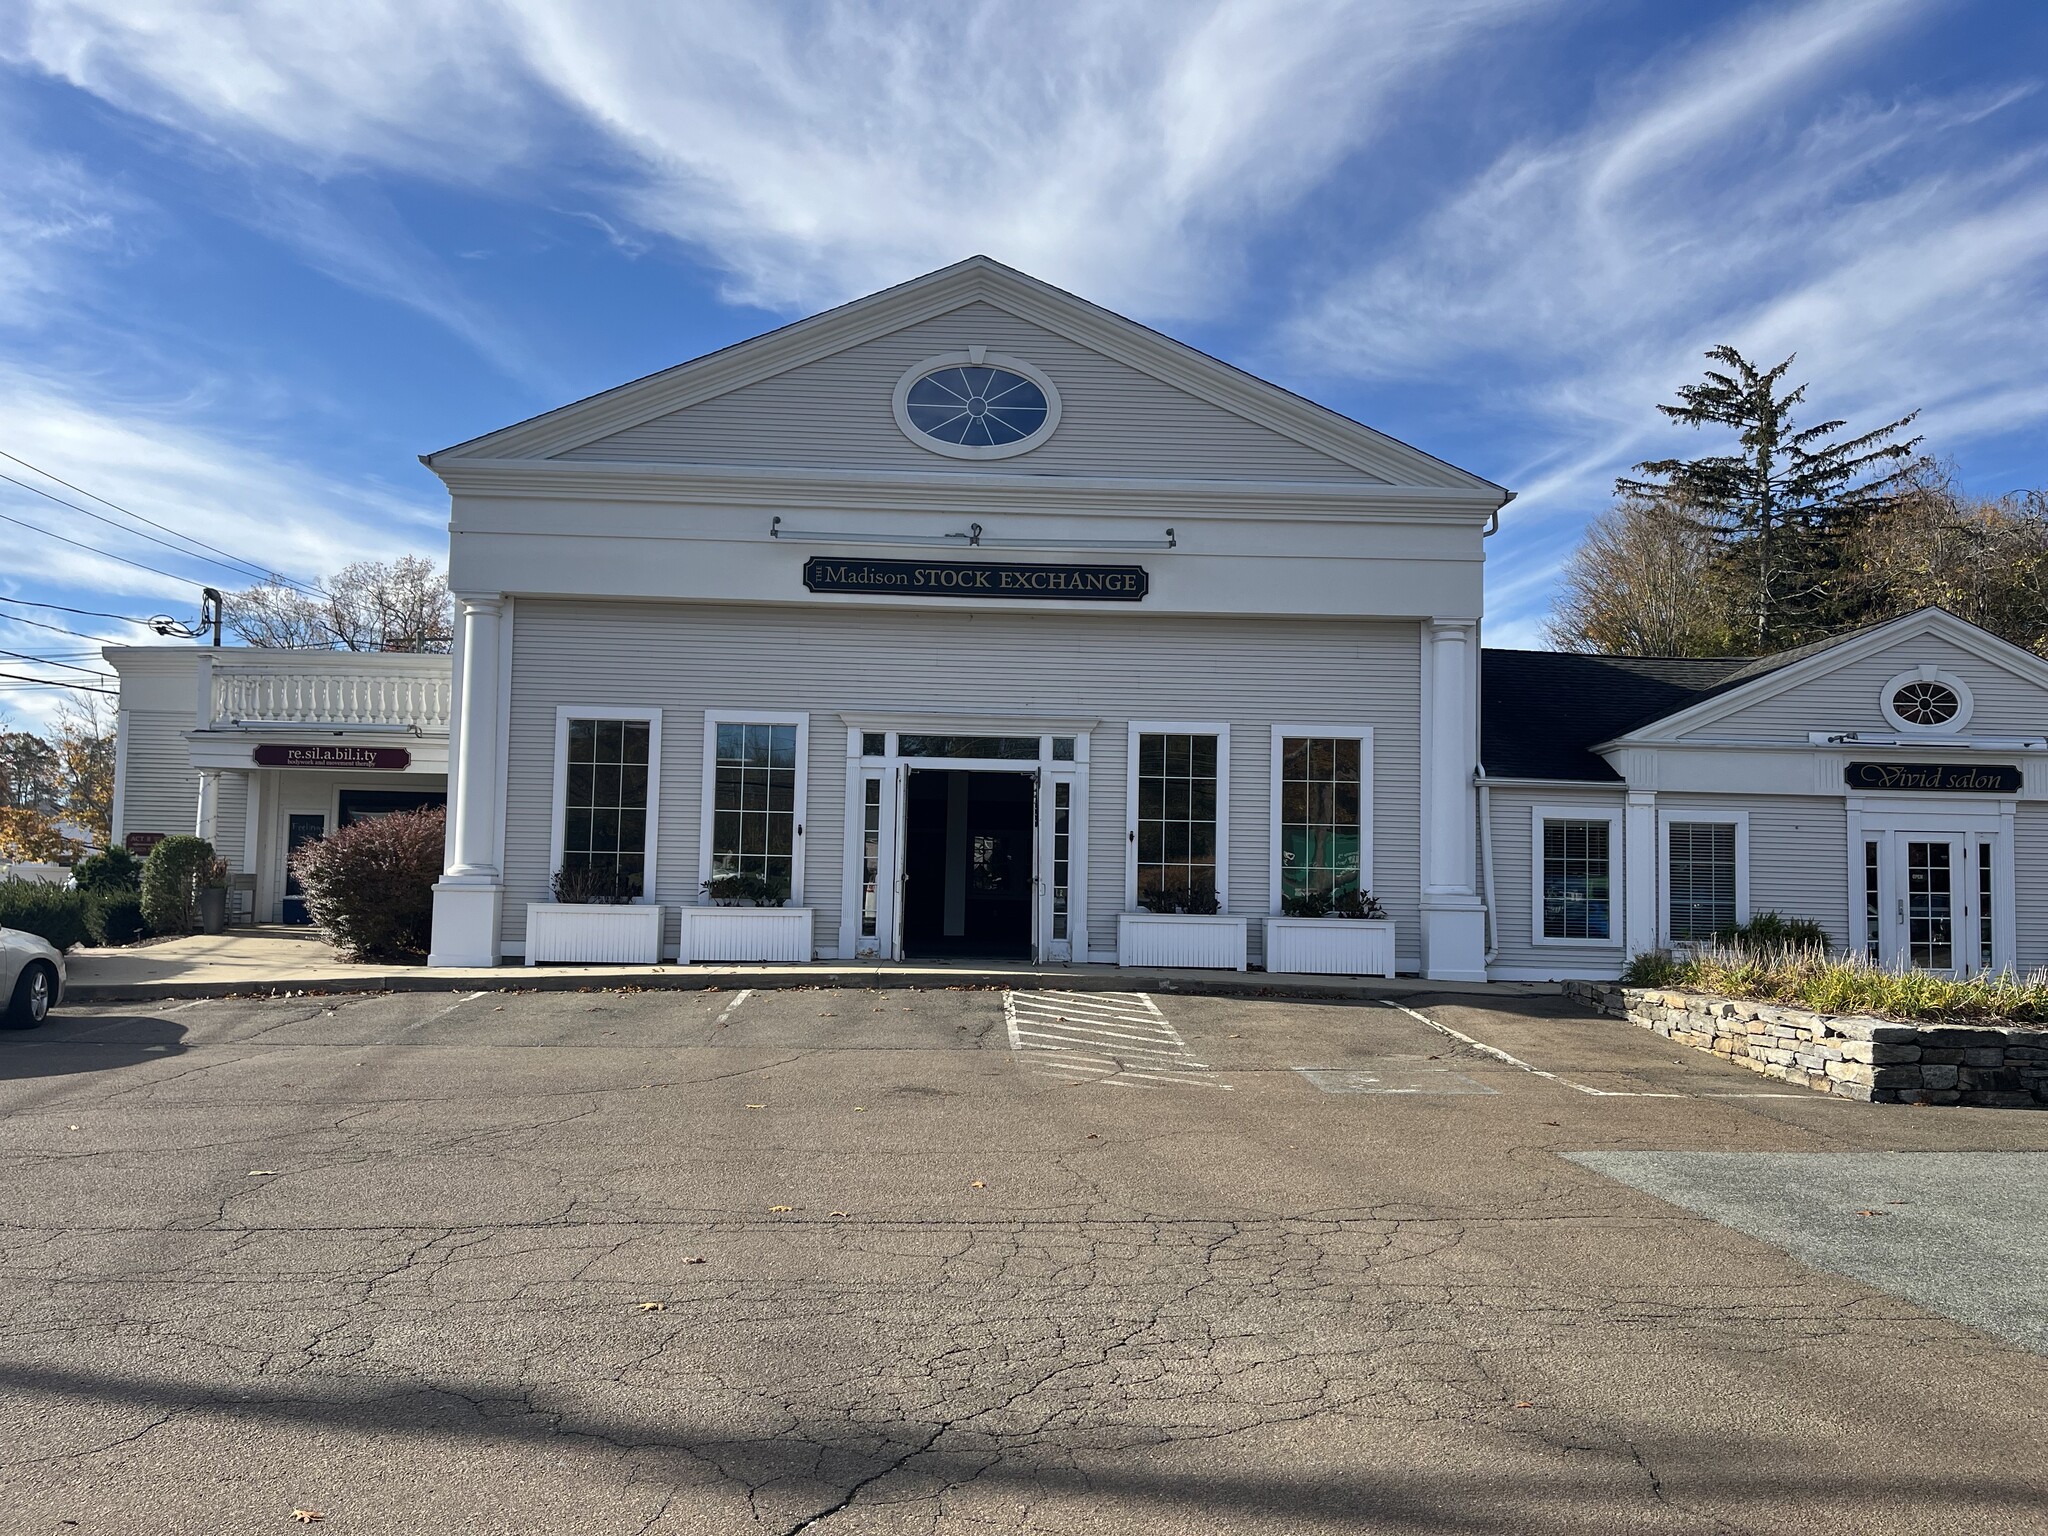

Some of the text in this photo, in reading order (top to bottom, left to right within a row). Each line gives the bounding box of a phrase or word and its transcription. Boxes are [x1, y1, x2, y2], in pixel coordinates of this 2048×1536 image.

[825, 566, 909, 585] Madison
[913, 569, 992, 588] STOCK
[999, 571, 1137, 591] EXCHANGE
[287, 758, 314, 766] bodywork
[355, 760, 376, 768] therapy
[288, 747, 377, 763] re.sil.a.bil.i.ty
[1860, 764, 2002, 789] Vivid salon
